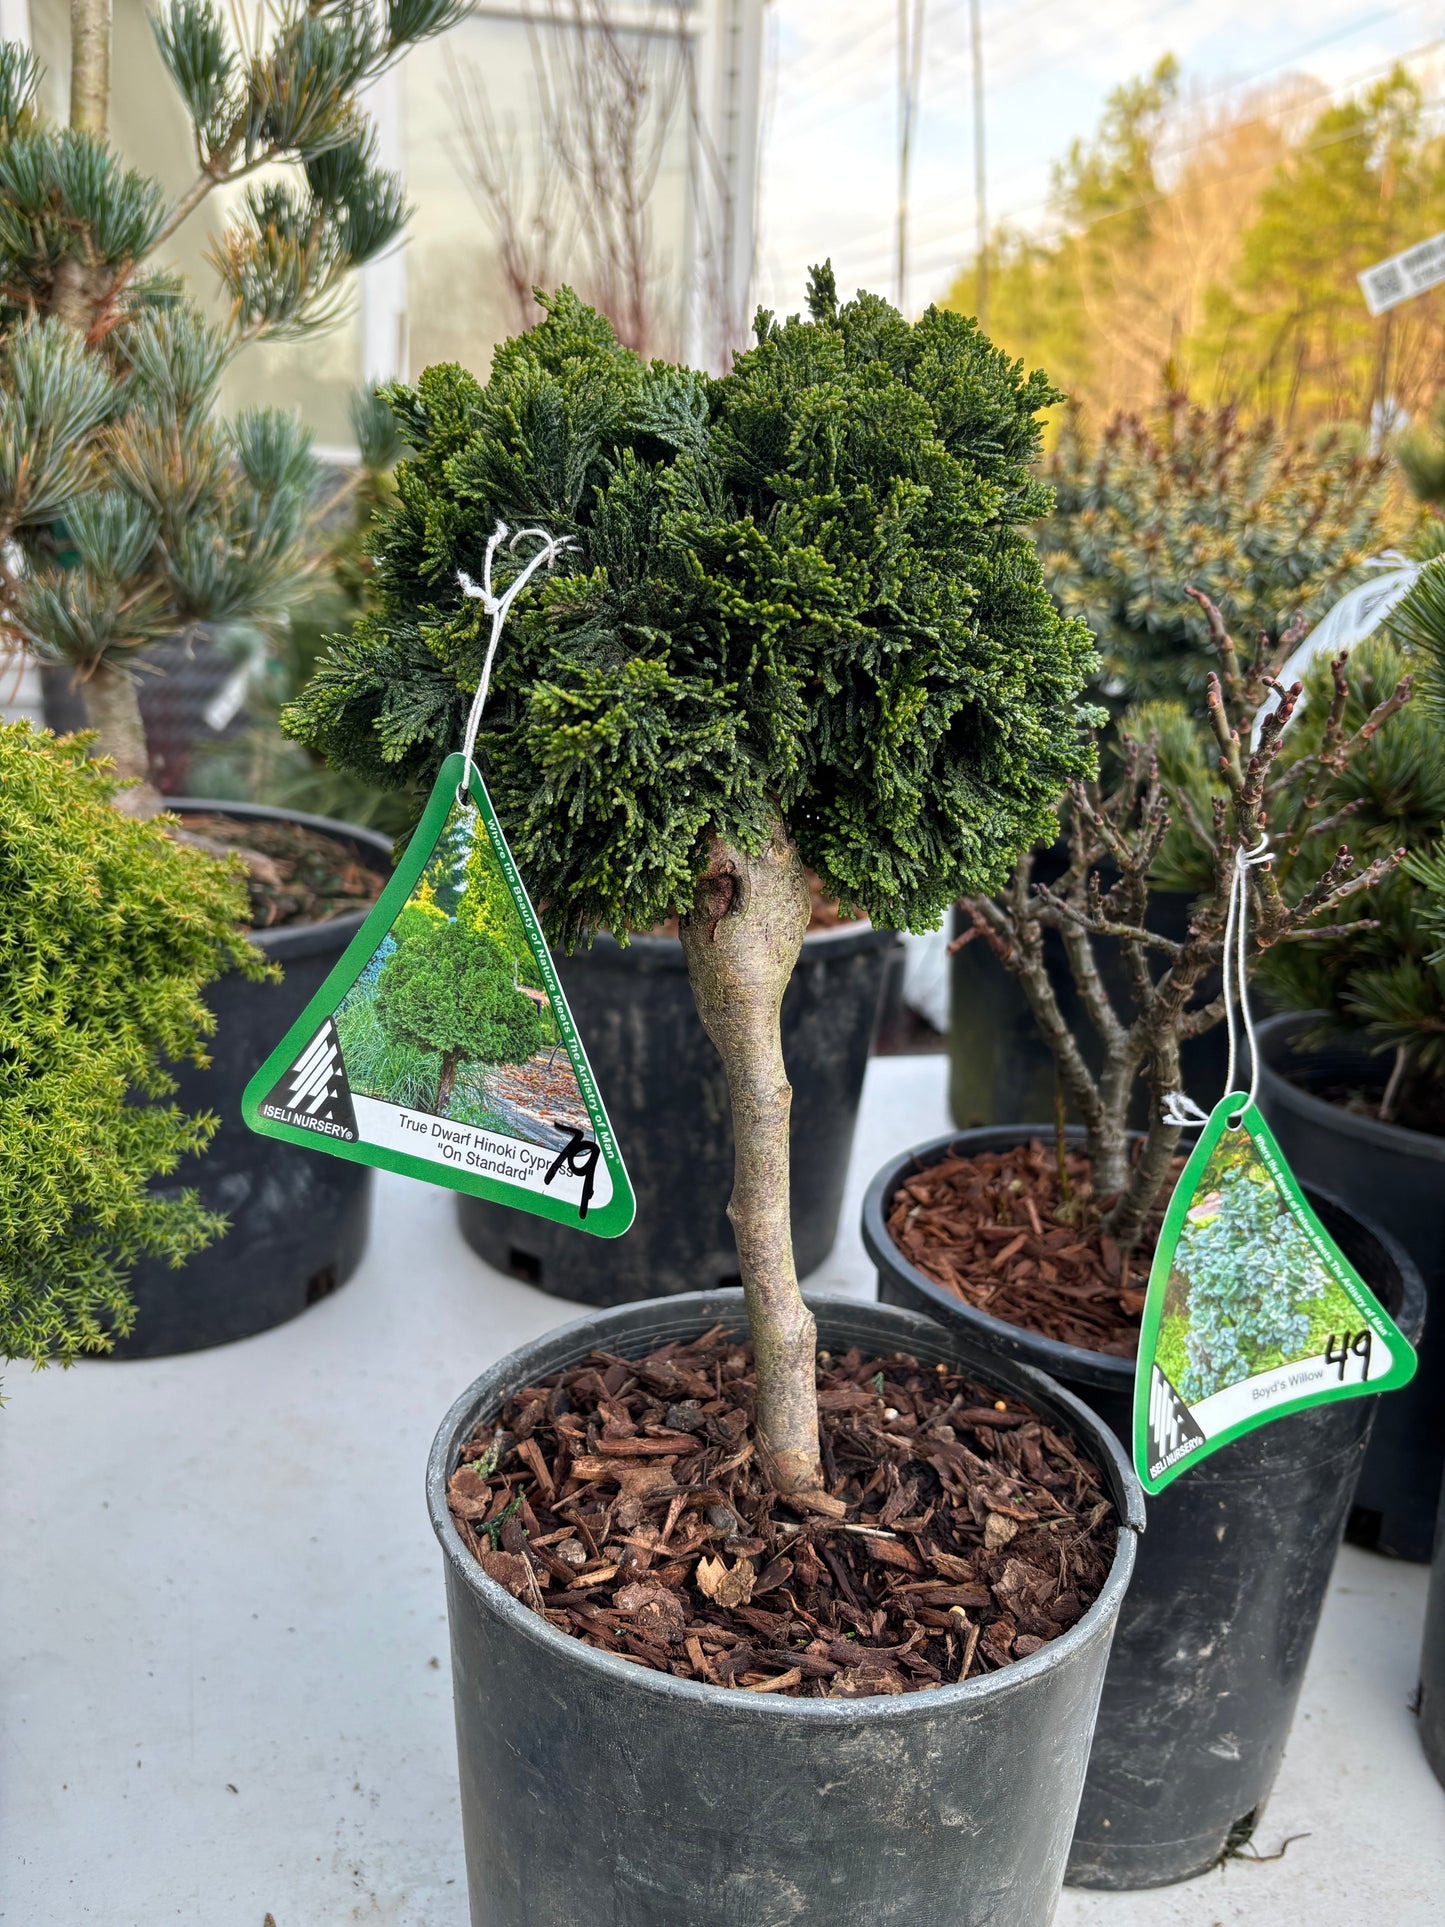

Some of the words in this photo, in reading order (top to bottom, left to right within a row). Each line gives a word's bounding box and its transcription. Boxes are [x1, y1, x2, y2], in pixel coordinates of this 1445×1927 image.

[487, 818, 506, 859] Where
[503, 862, 516, 883] the
[513, 886, 534, 929] Beauty
[531, 933, 542, 945] of
[537, 949, 556, 992] Nature
[552, 995, 571, 1034] Meets
[567, 1037, 580, 1062] The
[577, 1063, 599, 1112] Artistry
[594, 1115, 607, 1128] of
[263, 1104, 291, 1122] ISELI
[399, 1113, 428, 1134] True
[431, 1123, 471, 1146] Dwarf
[474, 1134, 516, 1160] Hinoki
[519, 1149, 574, 1178] Cyprss
[437, 1142, 462, 1163] "On
[465, 1152, 534, 1182] Standard"
[1254, 1132, 1271, 1160] Where
[1267, 1159, 1279, 1174] the
[1275, 1172, 1293, 1201] Beauty
[1289, 1200, 1300, 1210] of
[1295, 1208, 1316, 1237] Nature
[1312, 1235, 1333, 1262] Meets
[1330, 1260, 1344, 1278] The
[1341, 1277, 1367, 1308] Artistry
[1364, 1307, 1377, 1318] of
[1324, 1329, 1372, 1382] 49
[1252, 1379, 1287, 1402] Boyd's
[1288, 1369, 1324, 1386] Willow
[1149, 1459, 1169, 1479] ISELI
